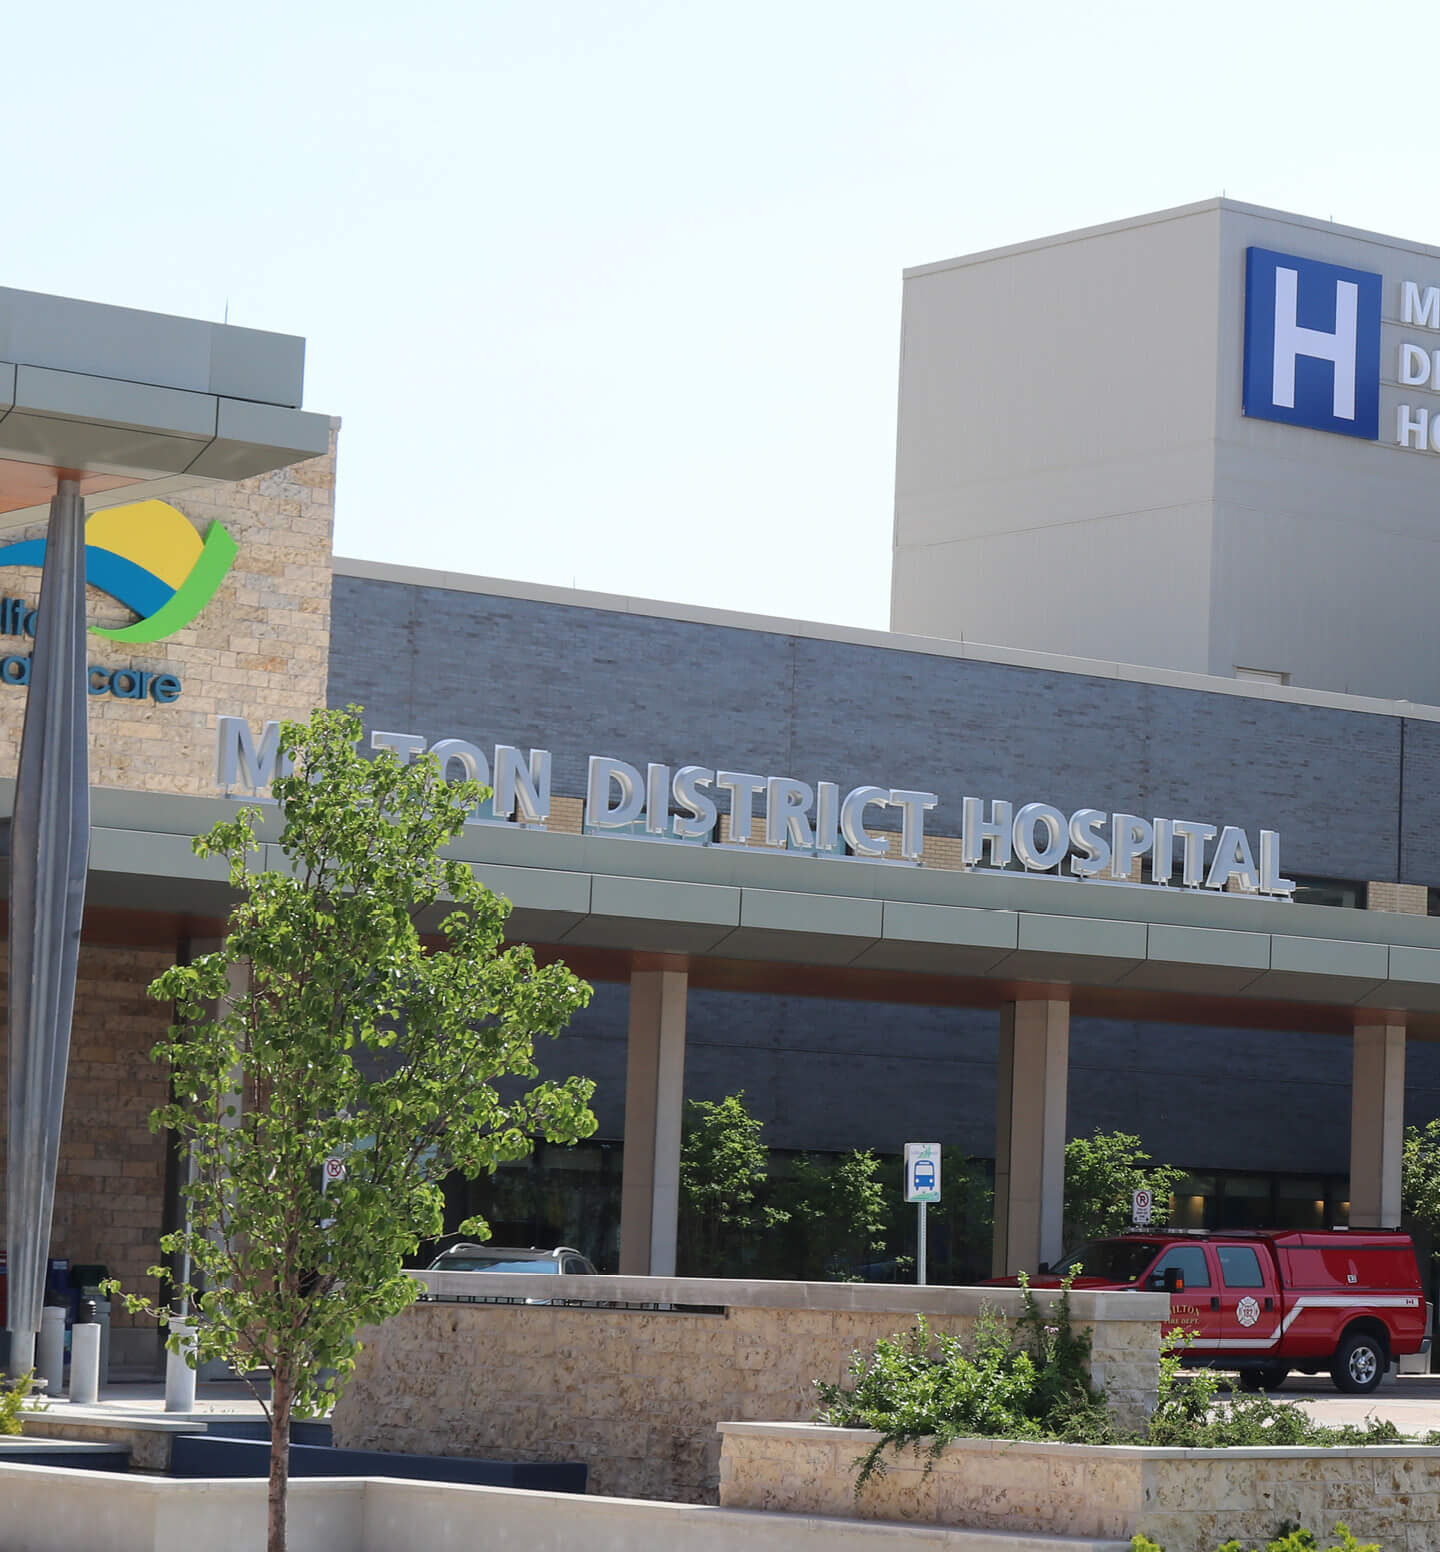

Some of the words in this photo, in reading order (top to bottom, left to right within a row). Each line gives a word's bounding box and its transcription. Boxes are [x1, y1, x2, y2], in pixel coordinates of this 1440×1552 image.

[1272, 266, 1359, 421] H
[586, 755, 939, 858] DISTRICT
[962, 796, 1297, 895] HOSPITAL
